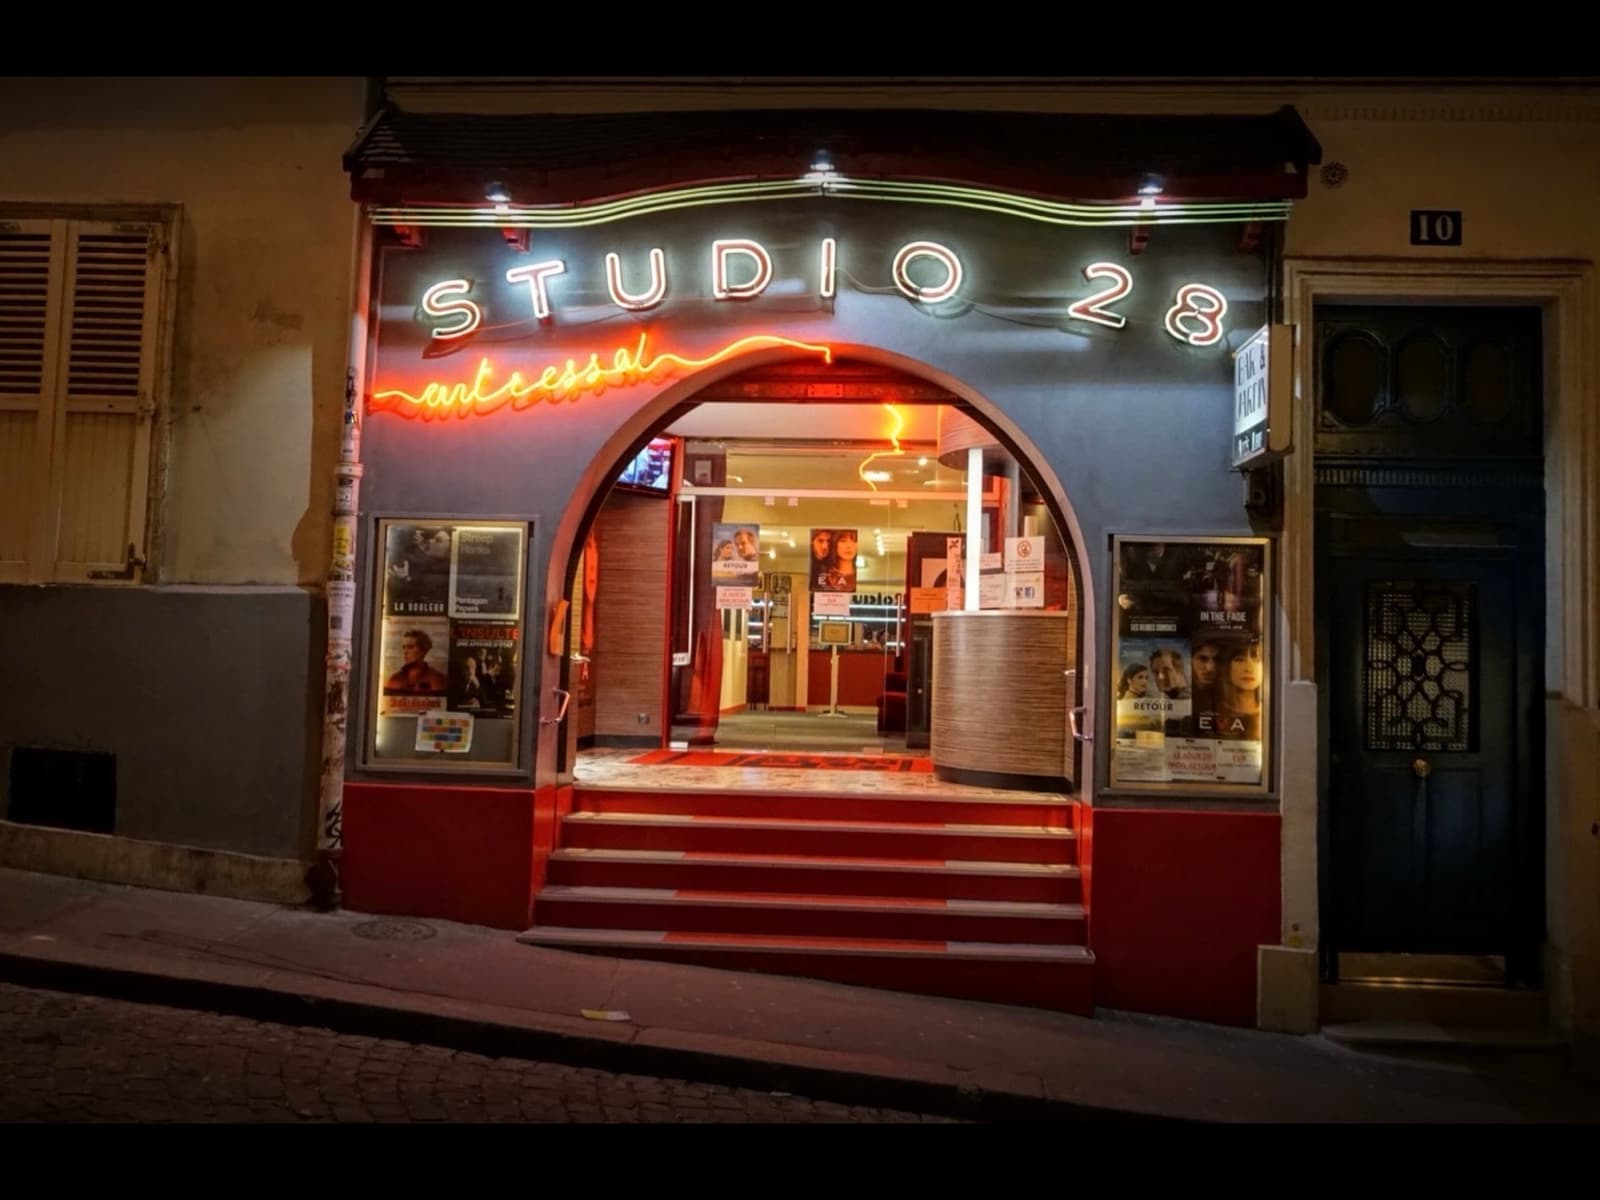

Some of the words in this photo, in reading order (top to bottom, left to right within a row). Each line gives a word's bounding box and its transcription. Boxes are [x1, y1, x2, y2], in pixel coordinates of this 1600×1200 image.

[1418, 214, 1455, 241] 10
[422, 237, 964, 342] STUDIO
[1067, 262, 1228, 347] 28
[818, 576, 847, 585] EVA
[394, 602, 405, 612] LA
[1200, 611, 1209, 622] IN
[1210, 611, 1225, 622] THE
[1226, 611, 1247, 622] FADE
[1133, 701, 1174, 712] RETOUR
[1199, 716, 1245, 731] EVA
